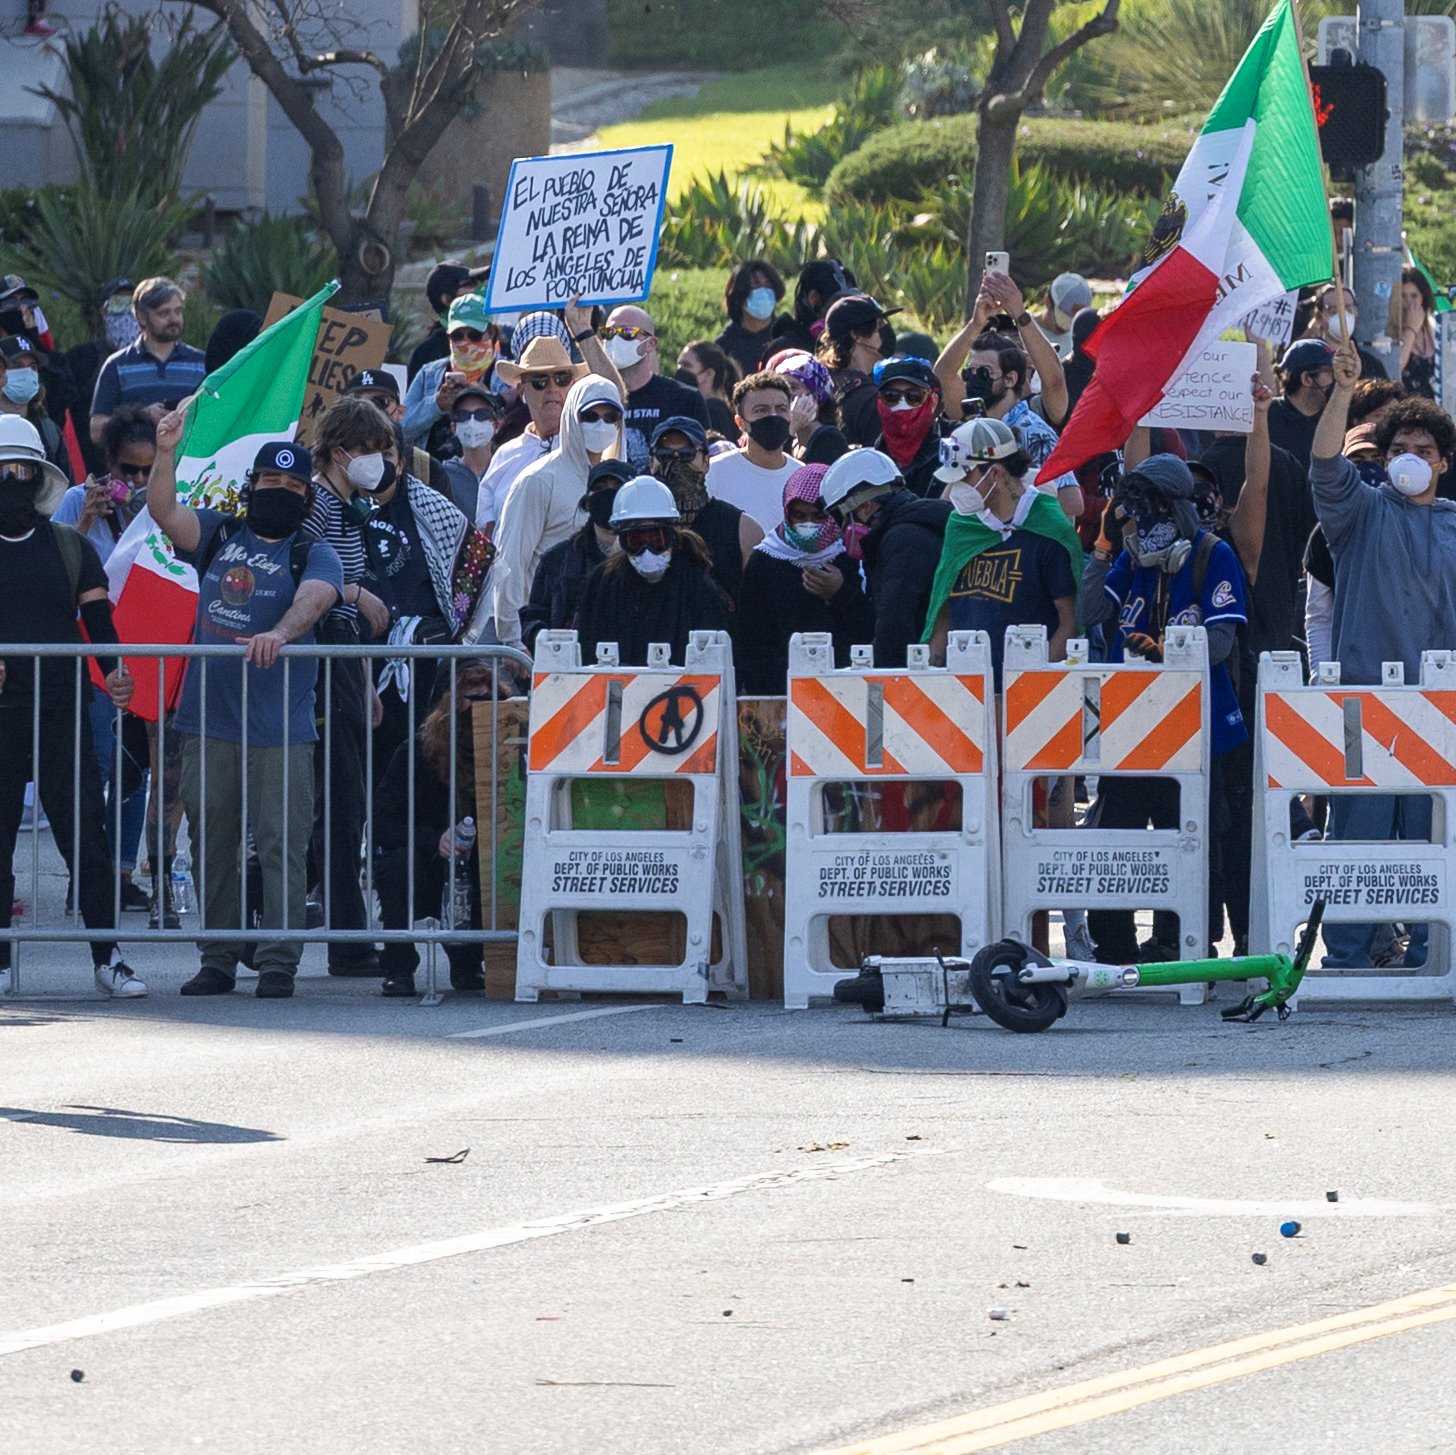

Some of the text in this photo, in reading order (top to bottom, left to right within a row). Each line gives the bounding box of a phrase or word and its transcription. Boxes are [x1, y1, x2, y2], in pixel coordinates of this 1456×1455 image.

[513, 162, 633, 211] EL PUEBLO DE
[526, 189, 597, 237] NUESTRA
[532, 215, 644, 264] LA REINA DE
[505, 265, 537, 292] LOS
[623, 246, 647, 269] DE
[569, 851, 664, 863] CITY OF LOS ANGELES
[835, 854, 935, 867] CITY OF LOS ANGELES
[554, 862, 679, 877] DEPT. OF PUBLIC WORKS
[819, 866, 951, 880] DEPT. OF PUBLIC WORKS
[1320, 864, 1421, 875] CITY OF LOS ANGELES
[552, 876, 679, 894] STREET SERVICES
[818, 880, 951, 898] STREET SERVICES
[1304, 874, 1437, 888] DEPT. OF PUBLIC WORKS
[1304, 888, 1440, 905] STREET SERVICES
